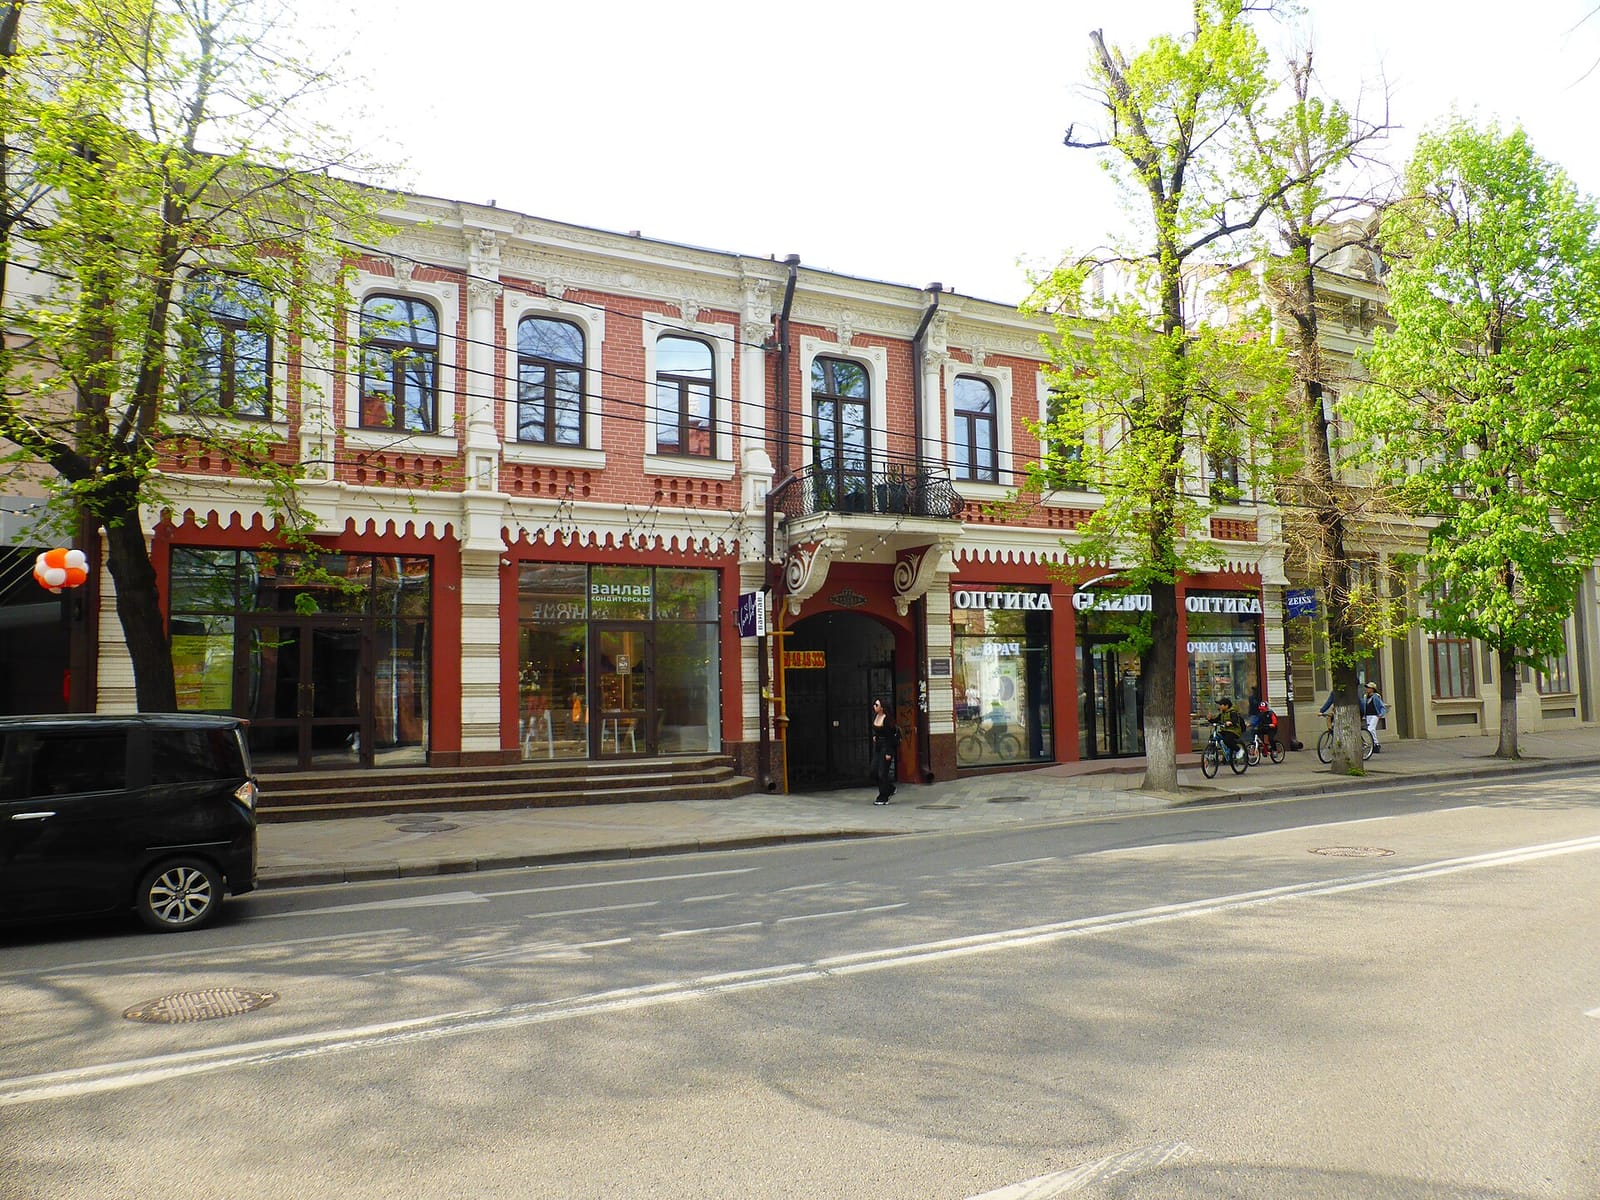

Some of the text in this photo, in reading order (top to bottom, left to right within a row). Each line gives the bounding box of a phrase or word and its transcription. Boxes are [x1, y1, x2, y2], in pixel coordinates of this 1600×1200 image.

[591, 584, 651, 595] ванлав
[953, 590, 1053, 610] ОПТИКА
[1072, 592, 1153, 611] GLAZBU
[1185, 596, 1263, 614] ОПТИКА
[1287, 595, 1312, 606] ZEISS
[982, 642, 1020, 656] ВРАЧ
[1186, 641, 1256, 653] ОЧКИ ЗА ЧАС
